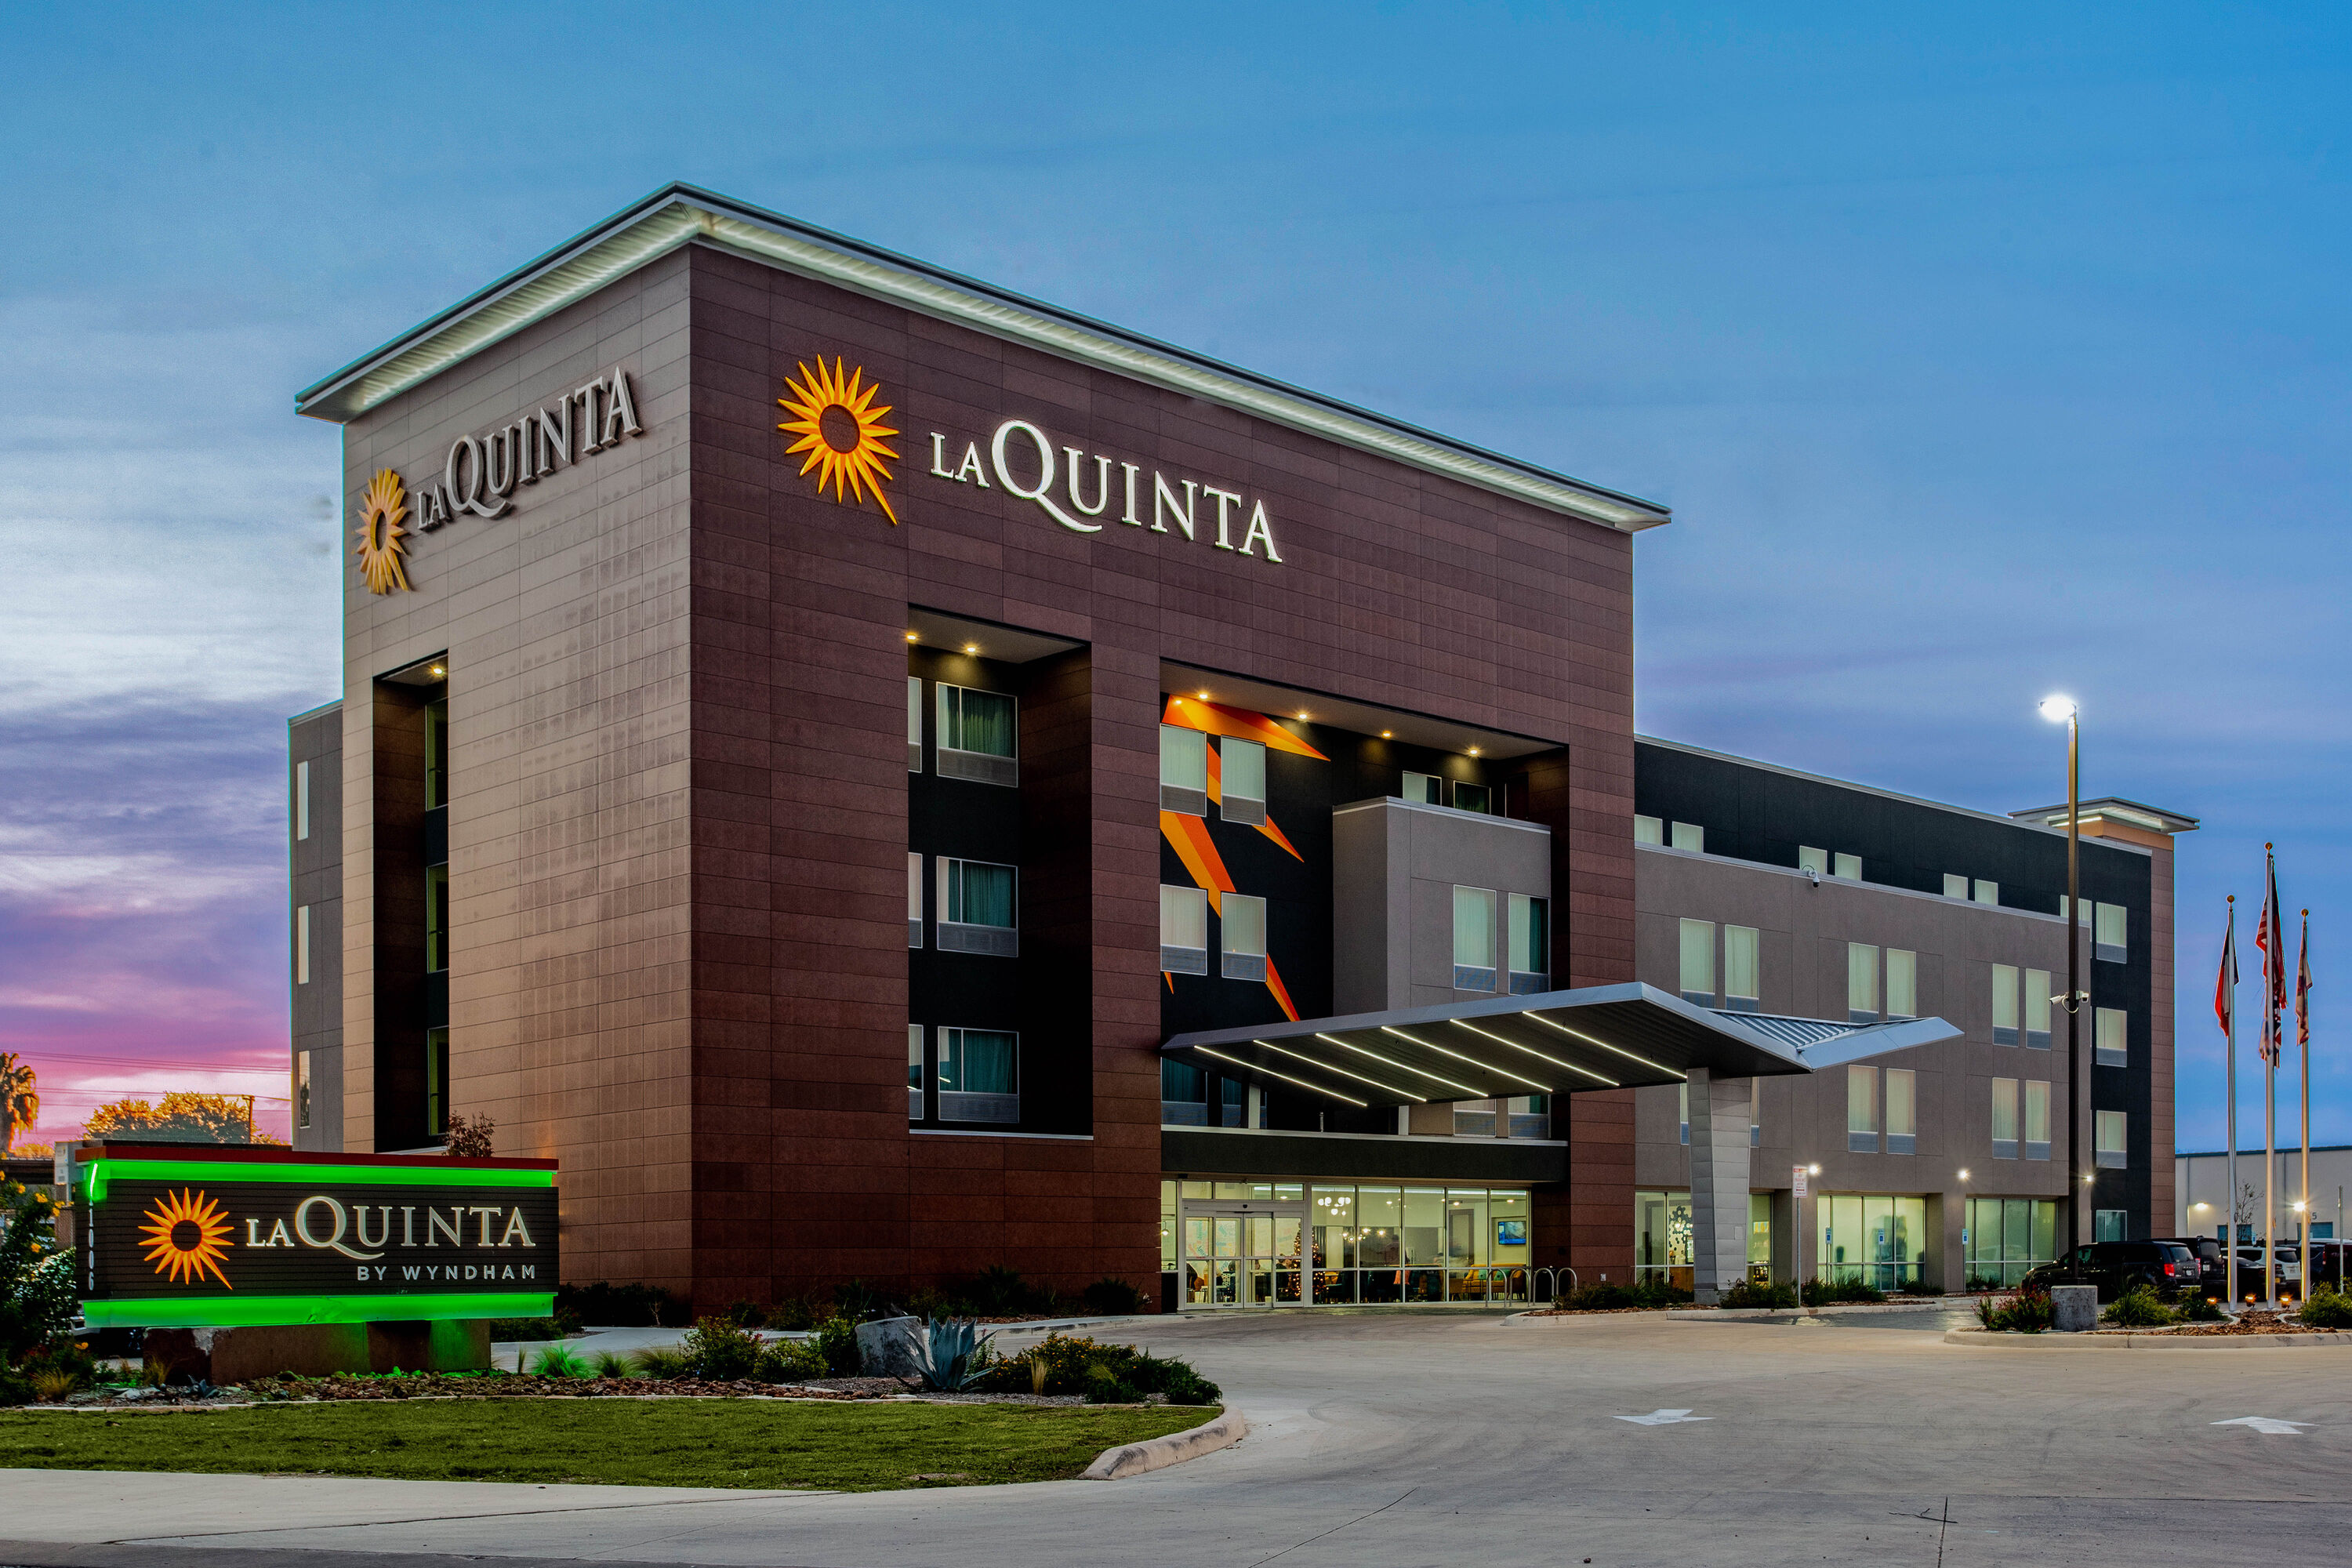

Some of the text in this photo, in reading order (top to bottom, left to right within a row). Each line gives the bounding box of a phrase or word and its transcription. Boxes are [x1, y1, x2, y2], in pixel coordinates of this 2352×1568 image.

[416, 366, 642, 530] LA QUINTA
[930, 419, 1283, 563] LA QUINTA
[245, 1196, 535, 1261] LA QUINTA
[358, 1264, 535, 1281] BY WYNDHAM
